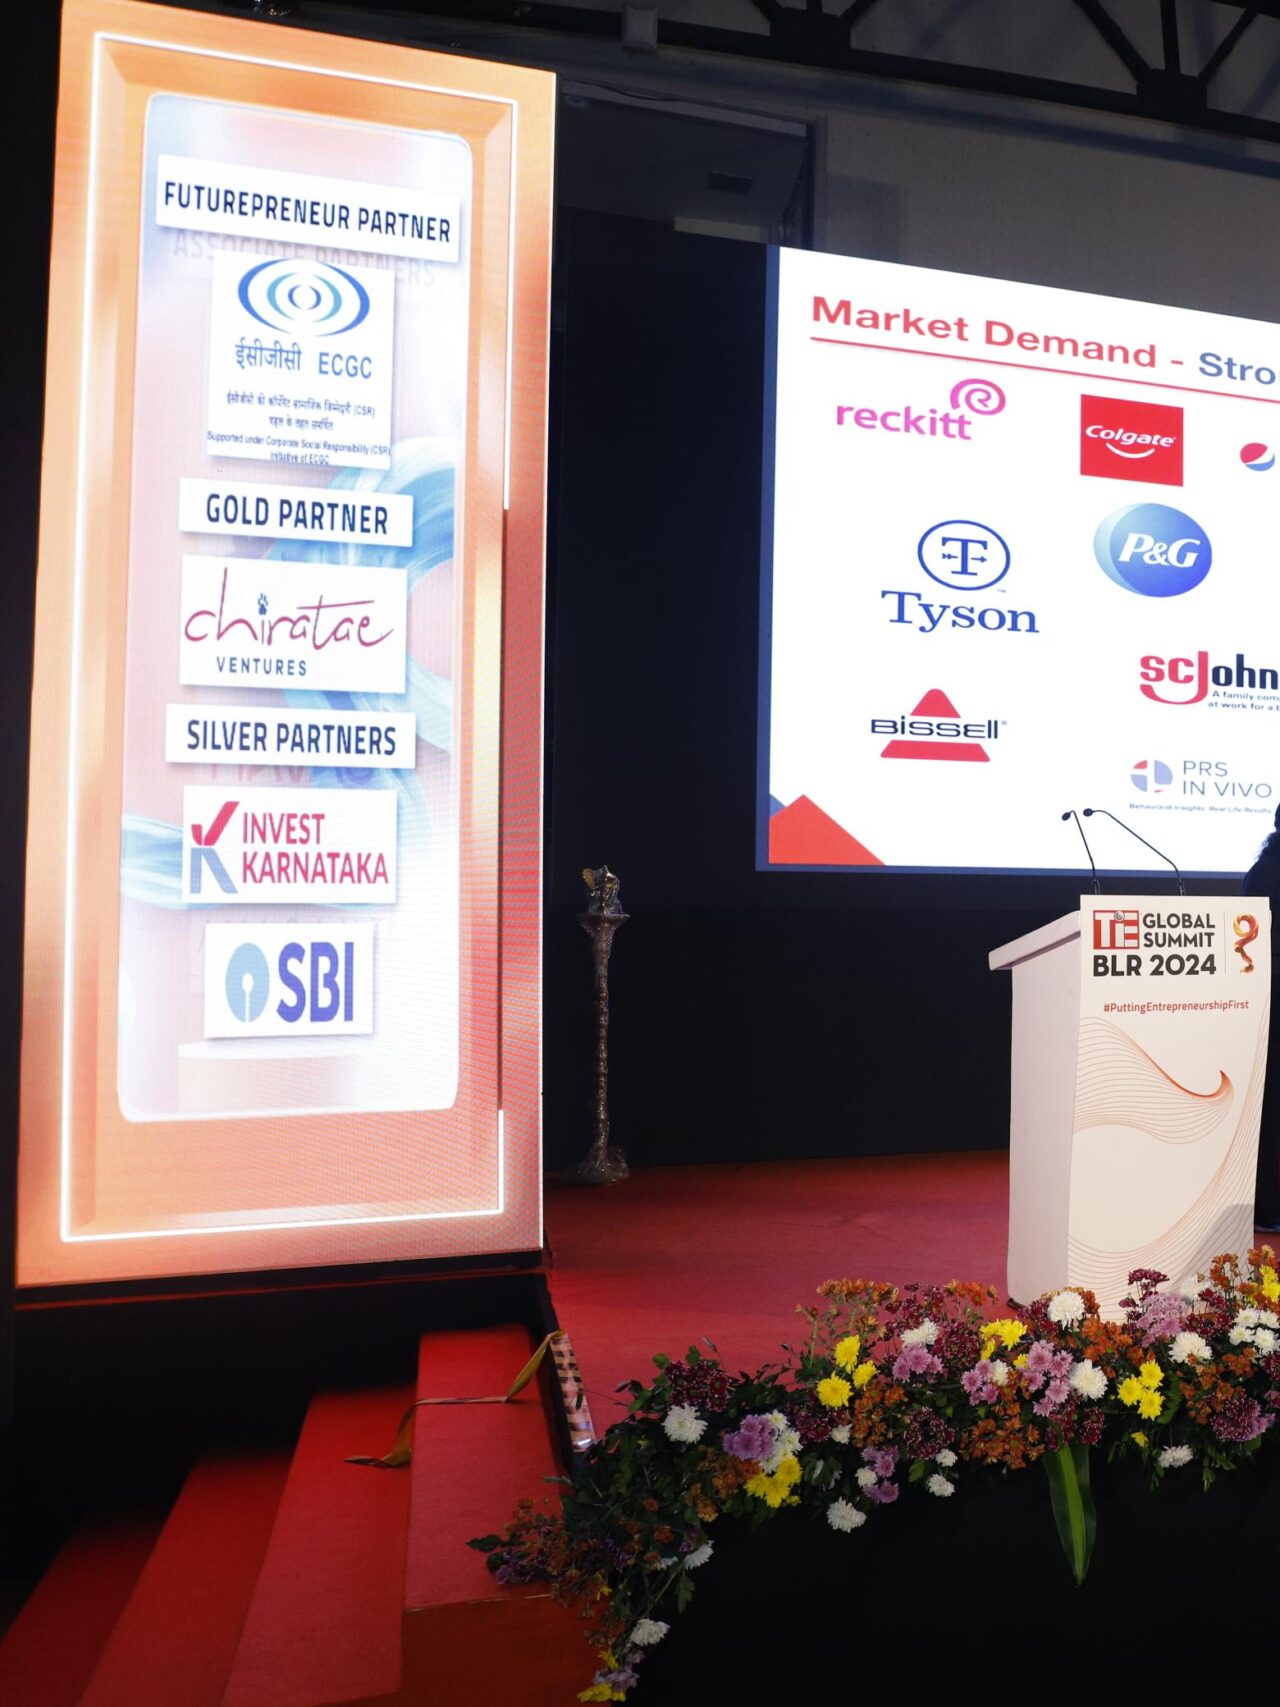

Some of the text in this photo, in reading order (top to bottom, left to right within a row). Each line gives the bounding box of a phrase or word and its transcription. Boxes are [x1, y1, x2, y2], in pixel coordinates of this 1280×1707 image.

[164, 180, 451, 243] FUTUREPRENEUR PARTNER
[813, 296, 969, 342] Market
[985, 320, 1156, 368] Demand
[234, 336, 302, 371] ईसीजीसी
[318, 351, 373, 379] ECGC
[837, 405, 972, 441] reckitt
[1085, 424, 1175, 448] Colgate
[207, 430, 243, 444] Supported
[244, 436, 264, 445] under
[266, 436, 299, 449] Corporate
[301, 438, 321, 449] Social
[323, 440, 369, 456] Responsibility
[206, 493, 388, 535] GOLD PARTNER
[1118, 532, 1201, 568] P&G
[185, 567, 394, 650] chiratae
[881, 590, 1040, 633] Tyson
[216, 656, 307, 676] VENTURES
[1208, 701, 1219, 709] at
[1221, 702, 1247, 710] work
[1250, 702, 1265, 711] for
[1212, 690, 1220, 698] A
[1223, 691, 1254, 701] family
[187, 719, 397, 756] SILVER PARTNERS
[1183, 760, 1228, 777] PRS
[1183, 780, 1272, 799] IN VIVO
[242, 812, 325, 845] INVEST
[242, 851, 389, 884] KARNATAKA
[1142, 912, 1216, 929] GLOBAL
[1143, 932, 1215, 948] SUMMIT
[1093, 953, 1217, 977] BLR 2024
[276, 941, 354, 1023] SBI
[1103, 1000, 1249, 1015] #PuttingEntrepreneurshipFirst
